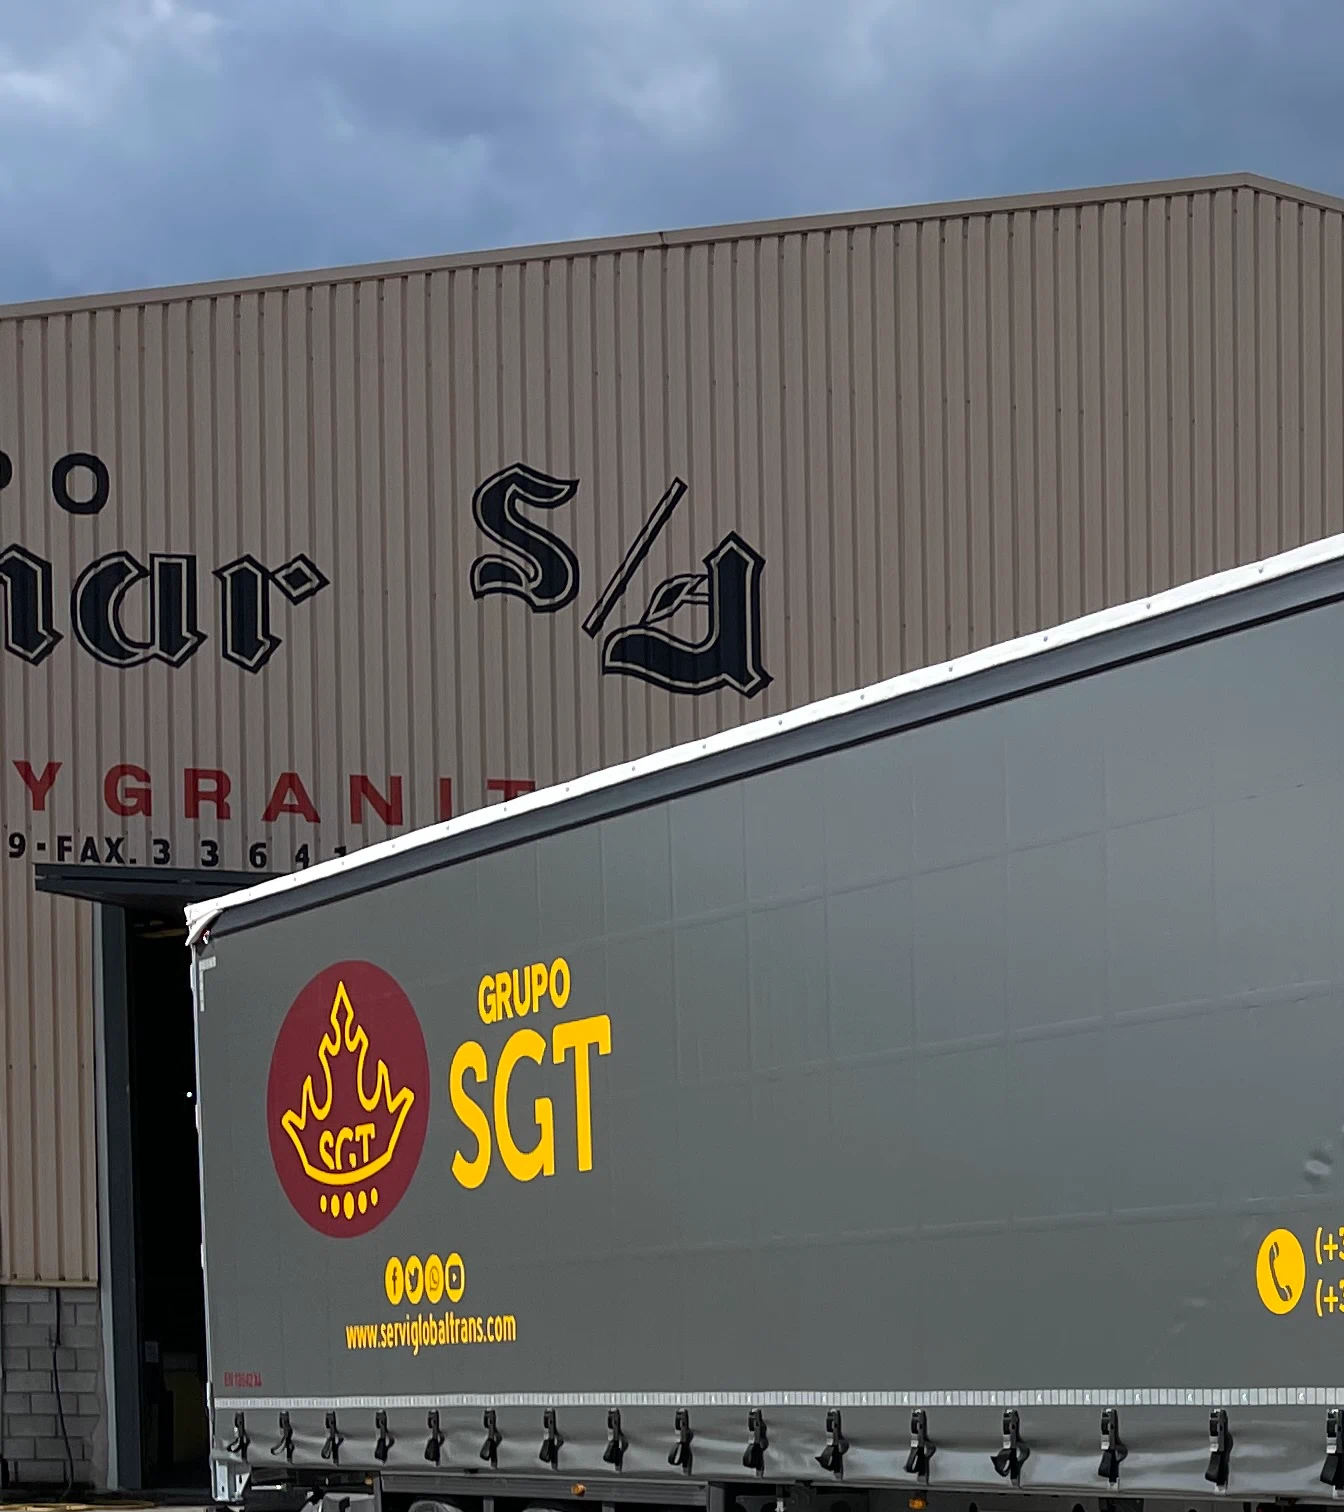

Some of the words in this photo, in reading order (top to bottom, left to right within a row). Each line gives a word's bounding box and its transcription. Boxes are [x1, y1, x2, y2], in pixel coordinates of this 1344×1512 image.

[12, 760, 63, 811] Y
[478, 957, 571, 1024] GRUPO
[449, 1014, 612, 1189] SGT
[318, 1122, 375, 1171] SGT
[345, 1312, 516, 1356] www.serviglobaltrans.com
